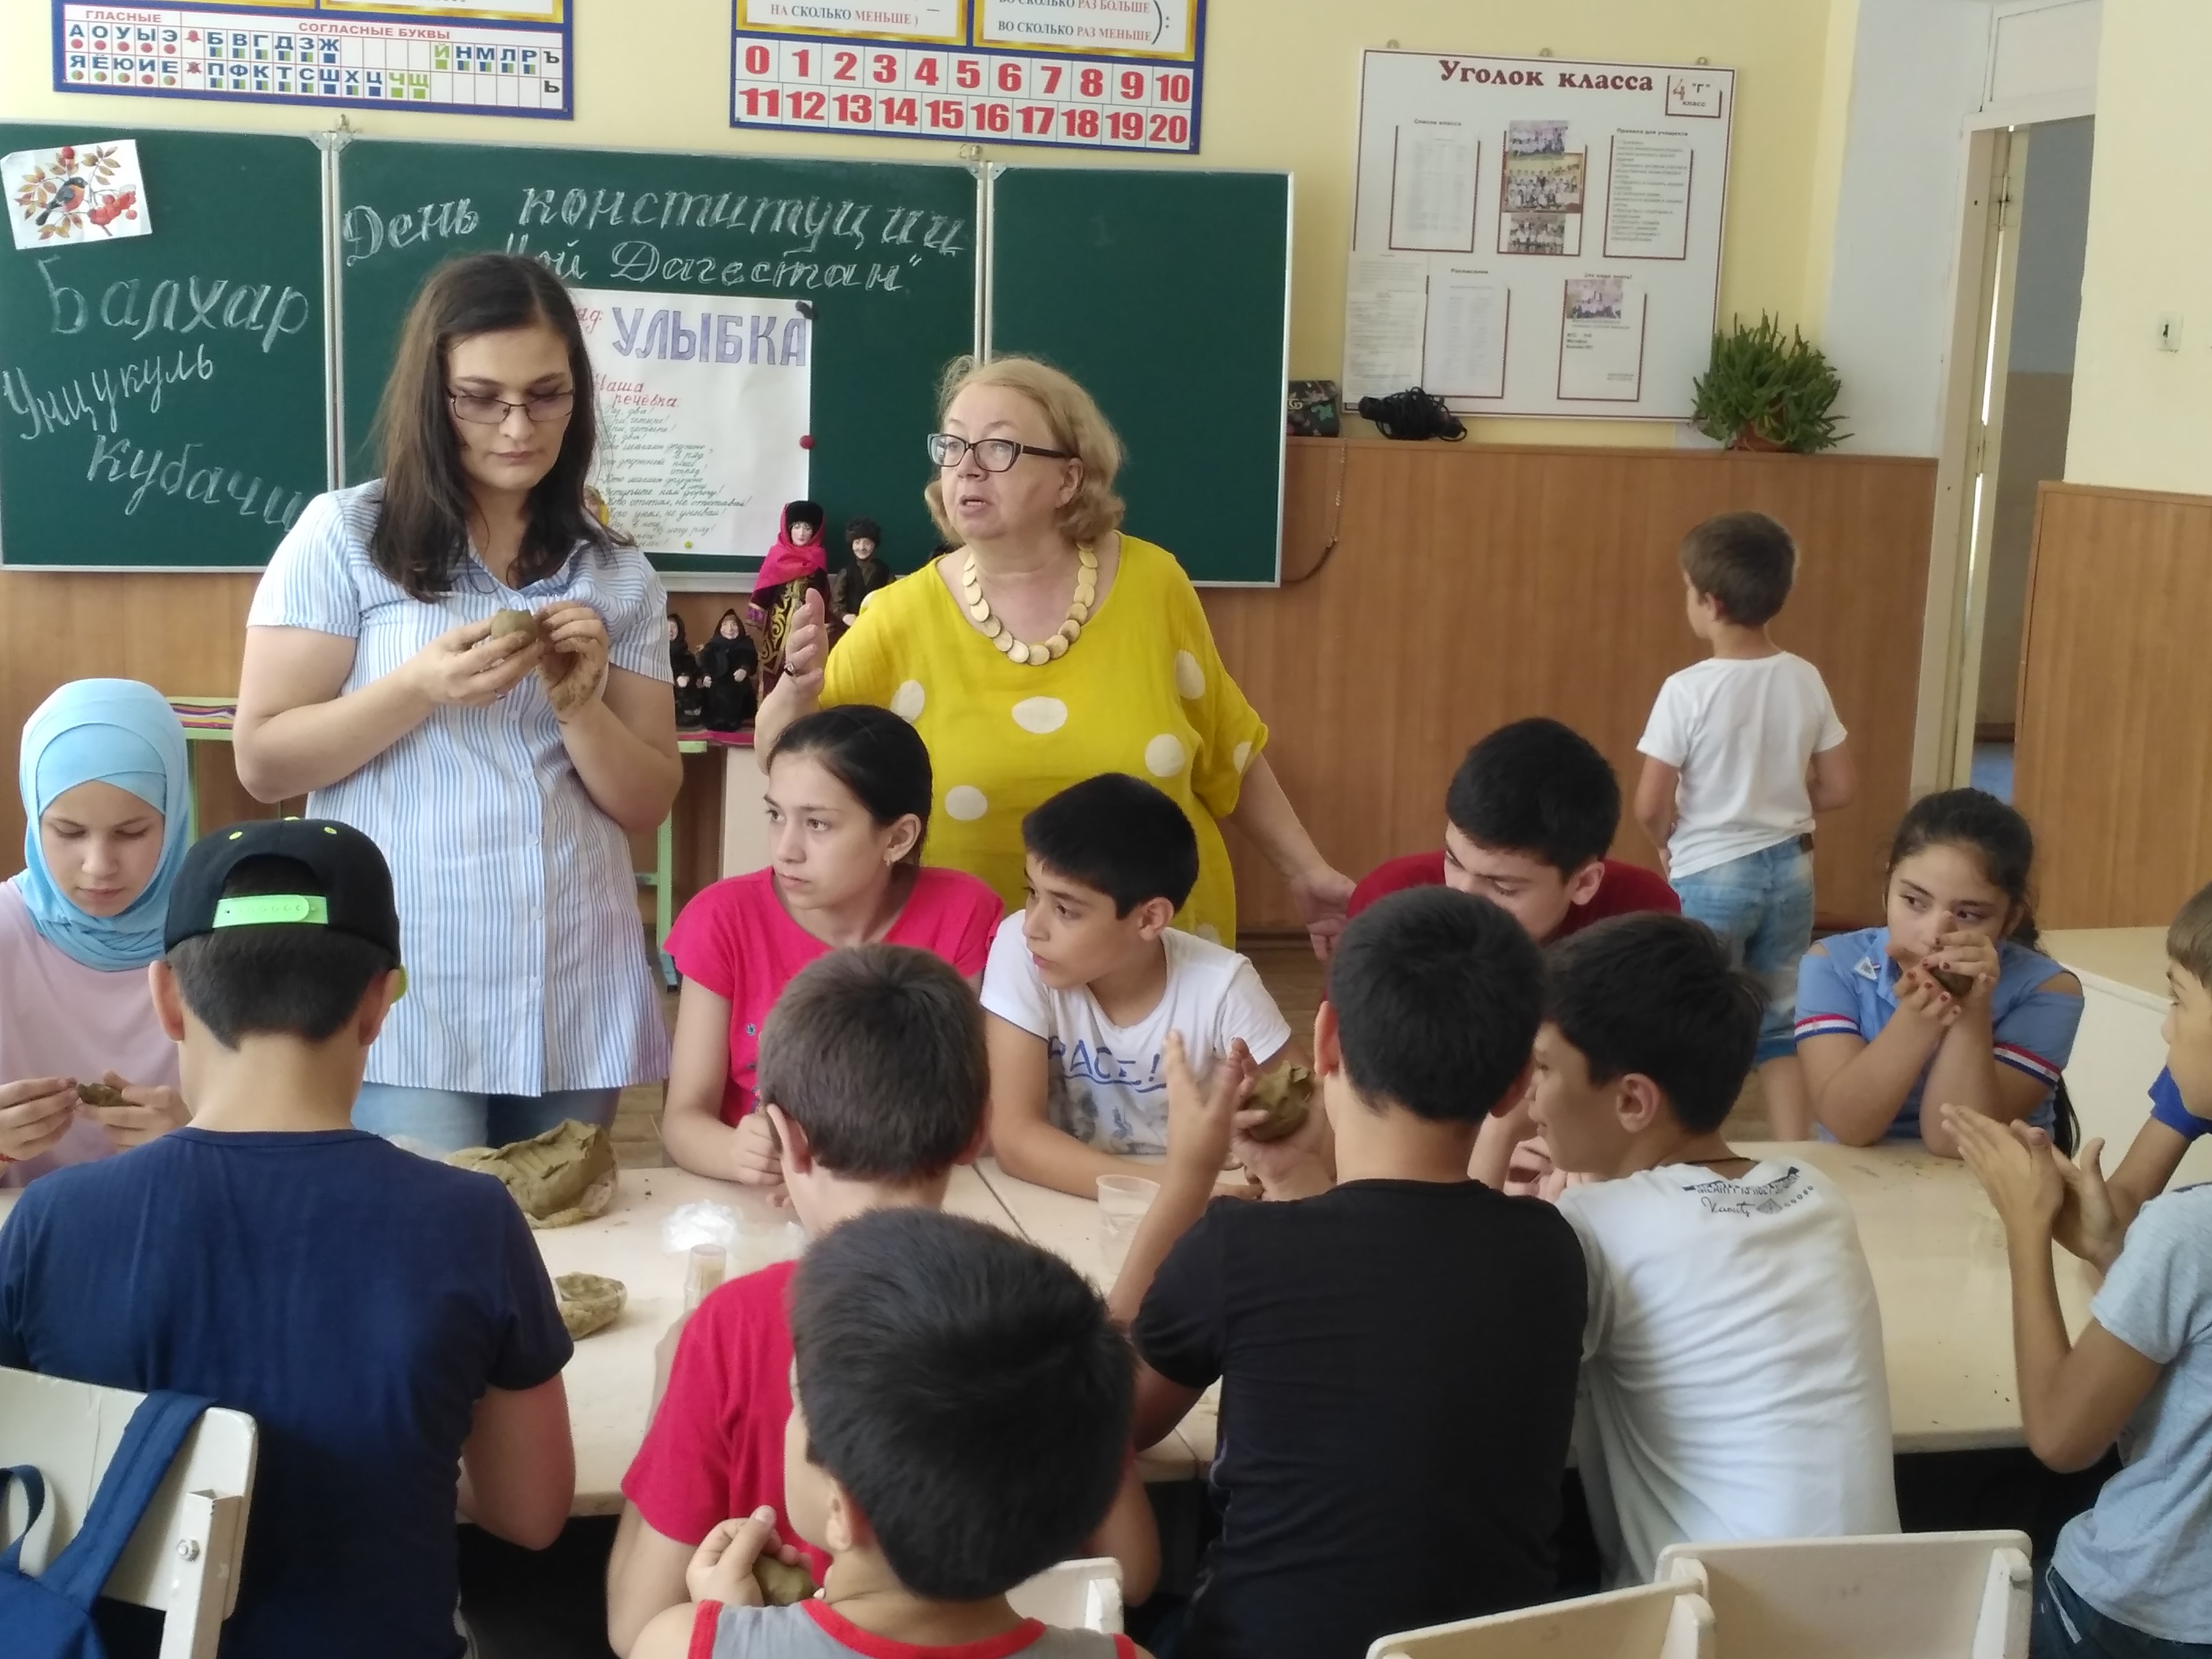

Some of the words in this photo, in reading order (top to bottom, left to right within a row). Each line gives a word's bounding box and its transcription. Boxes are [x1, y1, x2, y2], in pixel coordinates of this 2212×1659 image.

[86, 10, 161, 23] ГЛАСНЫЕ
[771, 4, 787, 16] НА
[791, 6, 851, 20] СКОЛЬКО
[855, 11, 910, 24] МЕНЬШЕ
[1078, 0, 1096, 10] РАЗ
[1100, 0, 1150, 13] БОЛЬШЕ
[299, 22, 393, 36] СОГЛАСНЫЕ
[399, 29, 450, 39] БУКВЫ
[999, 21, 1014, 31] ВО
[1017, 22, 1074, 36] СКОЛЬКО
[1077, 27, 1095, 37] РАЗ
[1099, 28, 1151, 41] МЕНЬШЕ
[745, 45, 770, 74] 0
[792, 49, 809, 77] 1
[834, 52, 857, 80] 2
[873, 54, 897, 83] 3
[915, 58, 939, 86] 4
[956, 60, 981, 88] 5
[998, 63, 1022, 91] 6
[1040, 66, 1062, 94] 7
[1080, 69, 1103, 97] 8
[1120, 71, 1144, 99] 9
[1155, 74, 1190, 103] 10
[1439, 60, 1544, 87] Уголок
[1559, 72, 1653, 91] класса
[1673, 78, 1686, 100] 4
[739, 88, 780, 117] 11
[786, 91, 826, 121] 12
[833, 94, 872, 123] 13
[879, 97, 918, 126] 14
[925, 100, 964, 128] 15
[970, 103, 1009, 132] 16
[1016, 106, 1055, 135] 17
[1061, 109, 1099, 138] 18
[1105, 112, 1143, 140] 19
[1148, 114, 1187, 144] 20
[343, 197, 480, 267] День
[37, 255, 309, 353] Балхар
[612, 307, 806, 366] УЛЫБКА
